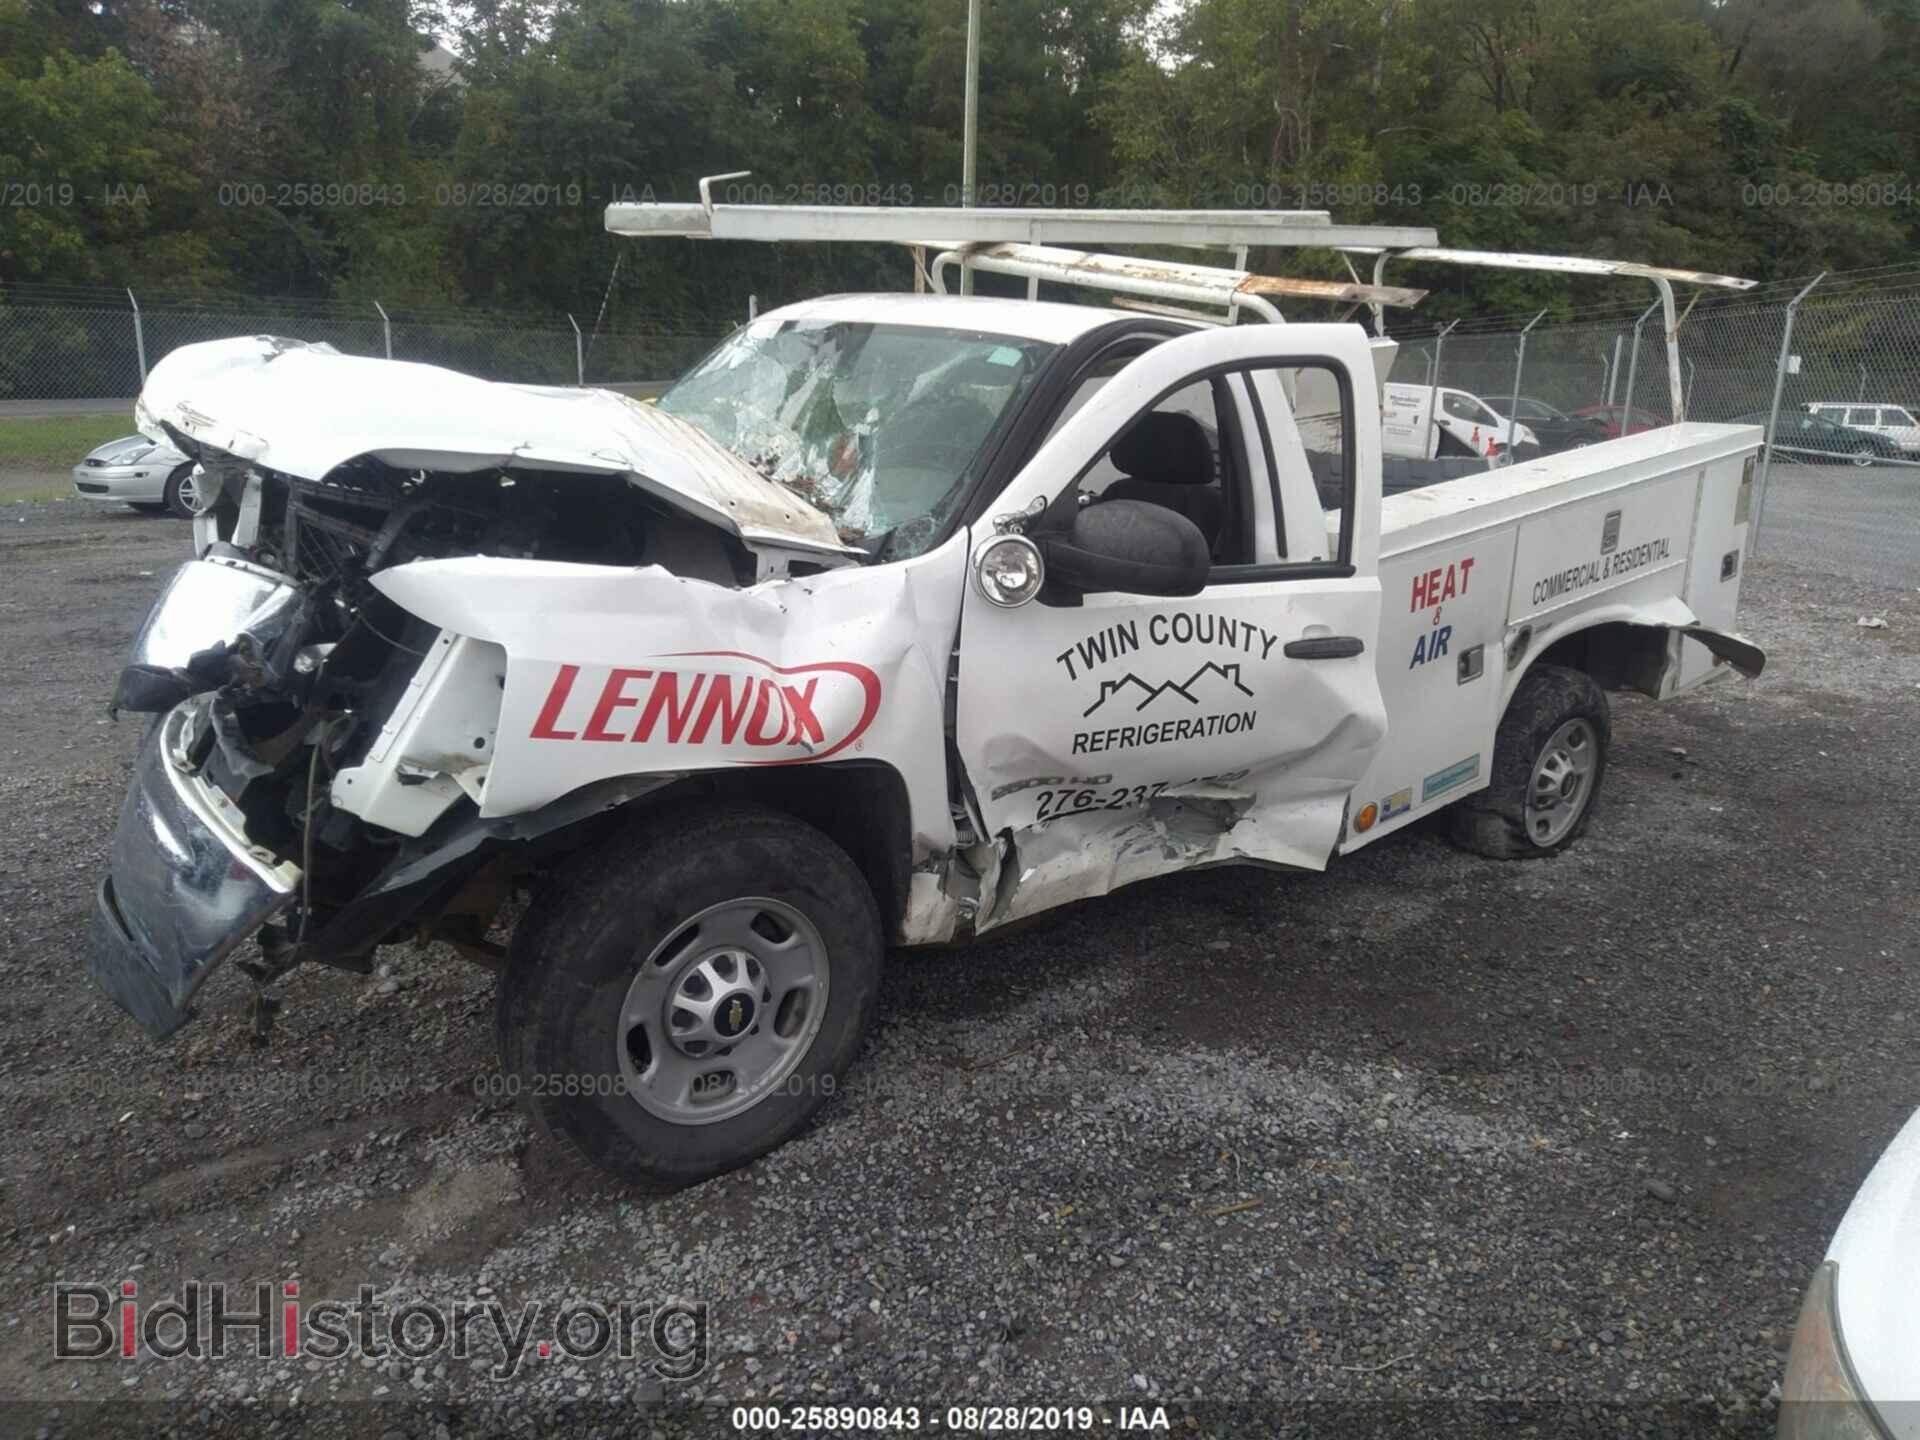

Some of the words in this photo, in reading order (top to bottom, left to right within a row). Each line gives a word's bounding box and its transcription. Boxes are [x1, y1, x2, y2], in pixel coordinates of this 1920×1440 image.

[1410, 557, 1475, 613] HEAT
[1532, 558, 1601, 606] COMMERCIAL
[1611, 538, 1671, 576] RESIDENTIAL
[1056, 620, 1140, 681] TWIN
[1149, 612, 1278, 661] COUNTY
[1409, 625, 1452, 670] AIR
[529, 664, 825, 746] LENNOX
[1071, 711, 1257, 755] REFRIGERATION
